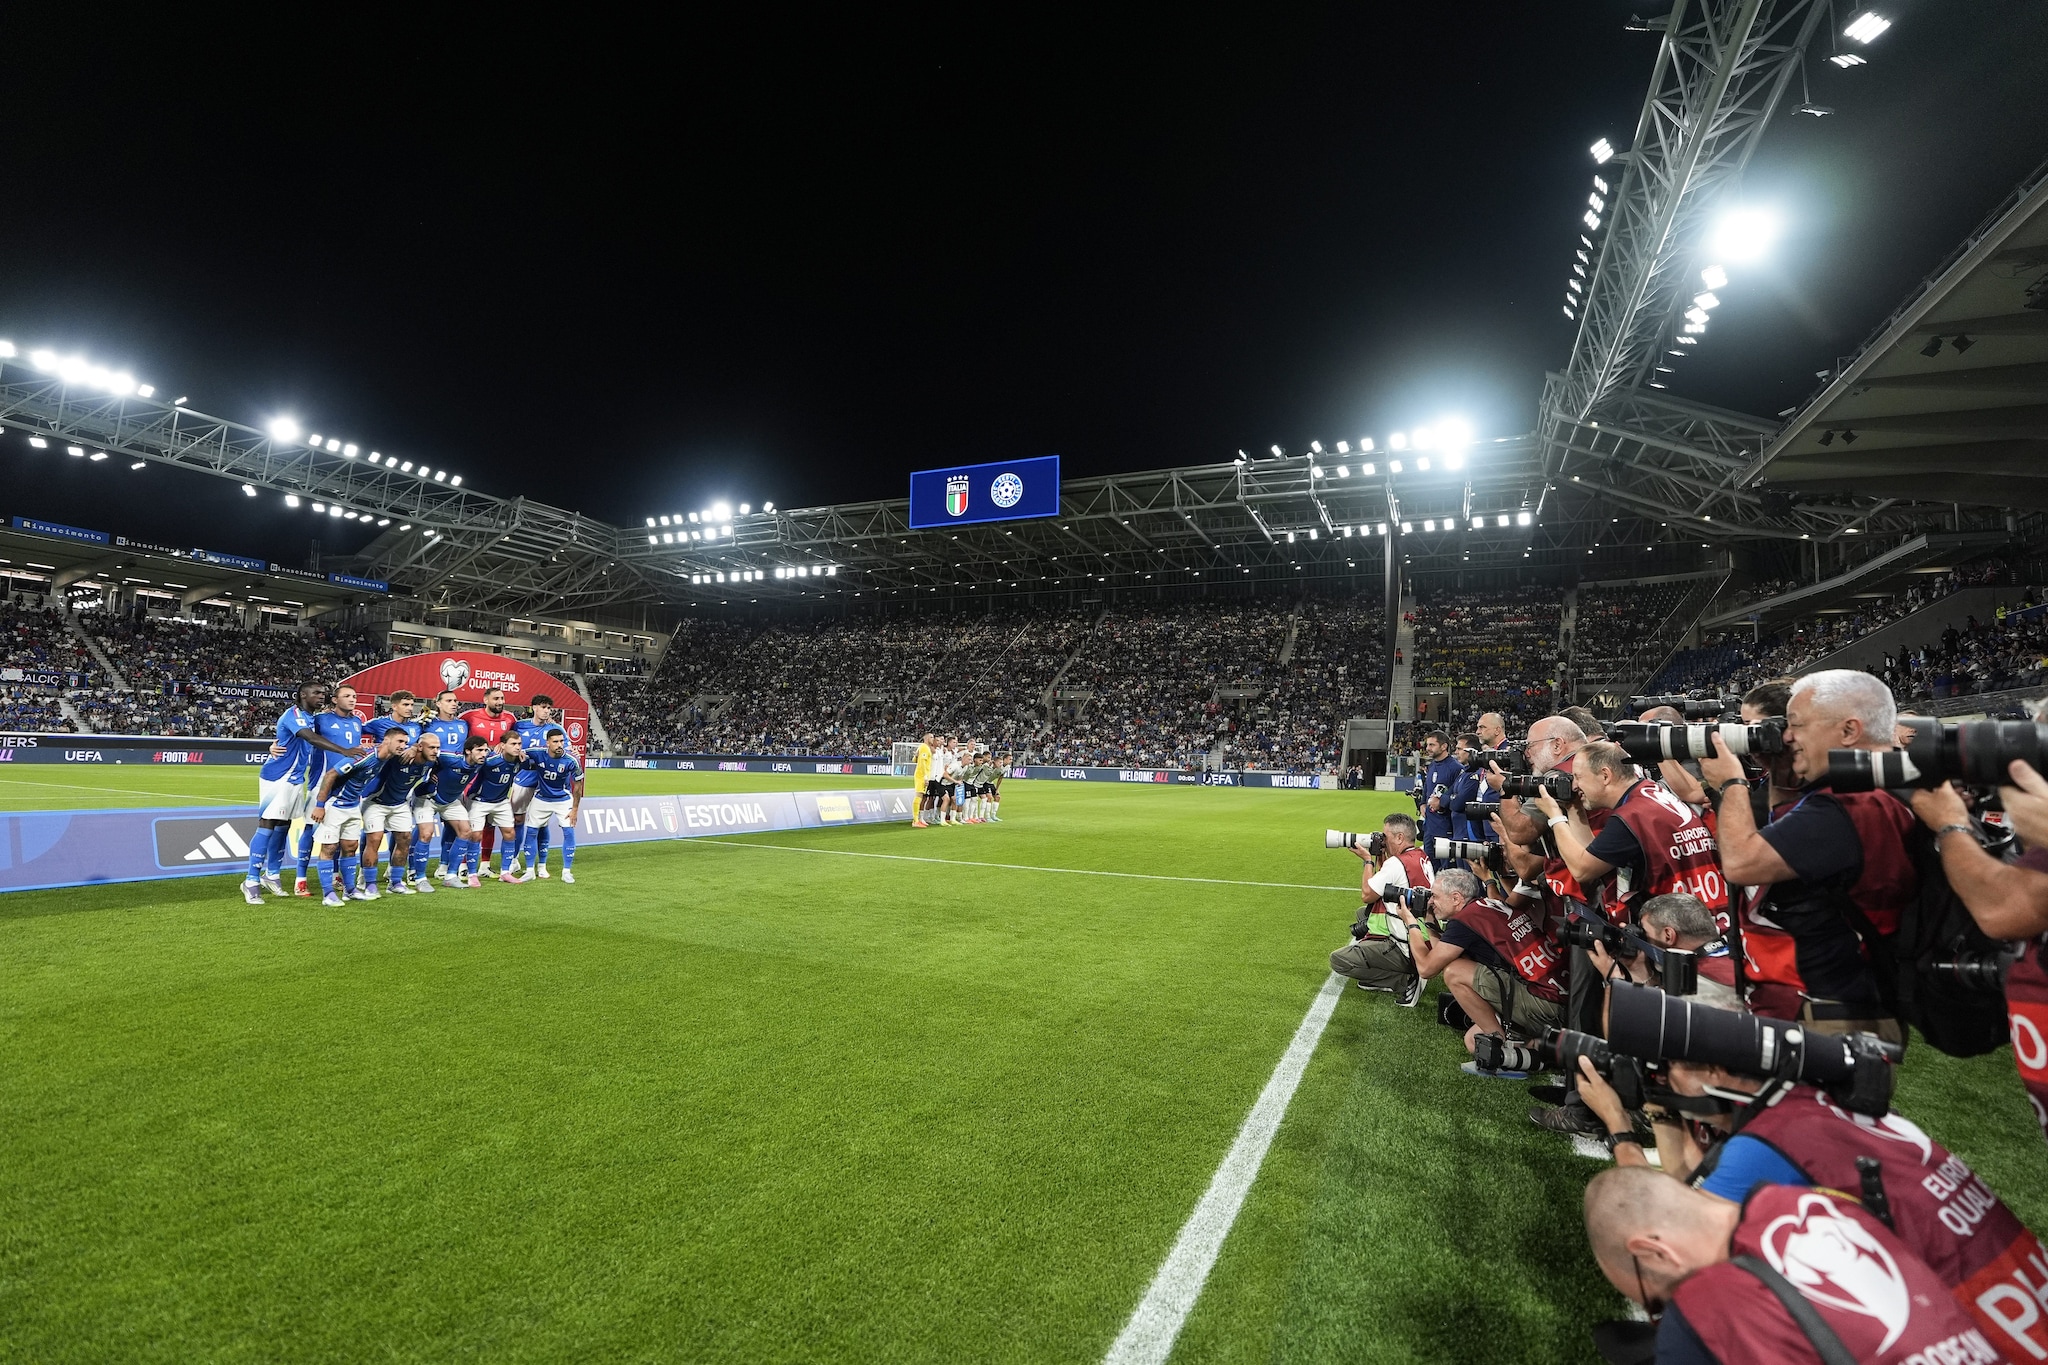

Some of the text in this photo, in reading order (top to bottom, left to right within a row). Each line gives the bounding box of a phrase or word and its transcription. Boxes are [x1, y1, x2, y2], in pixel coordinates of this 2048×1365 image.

[23, 520, 102, 541] Rinascimento
[116, 536, 186, 555] Rinascimento
[270, 563, 325, 579] Rinascimento
[335, 576, 384, 589] Rinascimento
[475, 670, 516, 682] EUROPEAN
[468, 678, 520, 692] QUALIFIERS
[252, 689, 289, 699] ITALIANA
[345, 731, 353, 744] 9
[447, 733, 458, 745] 13
[489, 730, 494, 742] 1
[64, 751, 103, 761] UEFA
[152, 751, 204, 763] #FOOTBALL
[624, 759, 649, 768] WELCOME
[676, 761, 695, 770] UEFA
[718, 762, 747, 771] #FOOTBALL
[771, 763, 792, 772] UEFA
[815, 763, 853, 774] WELCOME ALL
[499, 773, 511, 784] 18
[543, 770, 557, 781] 20
[1060, 769, 1087, 780] UEFA
[1119, 770, 1169, 783] WELCOME ALL
[1271, 775, 1311, 788] WELCOME
[864, 799, 882, 813] TIM
[582, 807, 658, 835] ITALIA
[684, 802, 767, 828] ESTONIA
[1703, 940, 1726, 953] SON
[1921, 1152, 1971, 1202] EURO
